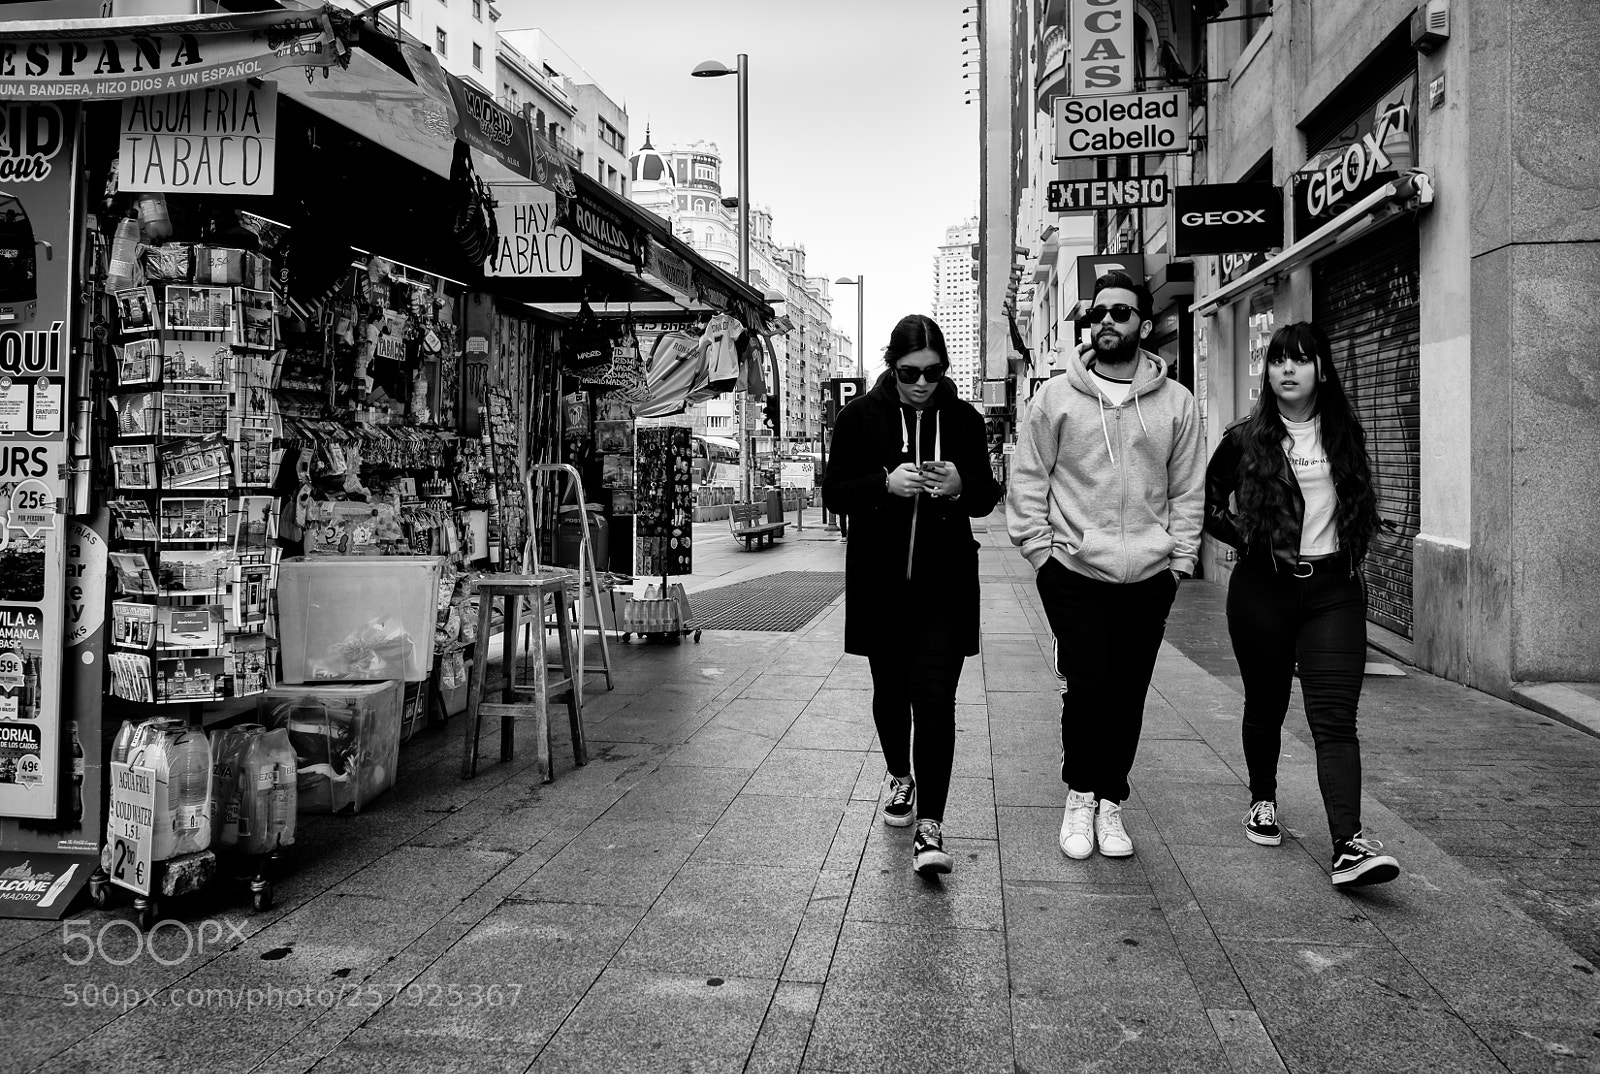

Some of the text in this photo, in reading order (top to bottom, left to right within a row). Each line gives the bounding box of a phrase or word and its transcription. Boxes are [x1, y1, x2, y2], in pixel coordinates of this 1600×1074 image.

[0, 60, 262, 96] UNA BANDERA, HIZO DIOS A UN ESPAÑOL
[128, 91, 191, 134] AGUA
[1064, 94, 1179, 124] Soledad
[1069, 124, 1175, 152] Cabello
[126, 134, 262, 187] TABACO
[1307, 117, 1393, 216] GEOX
[513, 203, 550, 235] HAY
[575, 203, 630, 250] RONALDO
[1181, 208, 1266, 227] GEOX
[498, 233, 574, 275] ABACO
[840, 382, 857, 406] P
[18, 490, 47, 509] 25€
[68, 524, 98, 546] FRÍAS
[27, 614, 36, 626] &
[0, 728, 36, 743] ORIAL
[22, 761, 39, 773] 49€
[118, 771, 150, 795] AGUA FRÍA
[115, 800, 152, 827] COLD WATER
[0, 880, 51, 892] LCOME
[0, 892, 41, 901] MADRID
